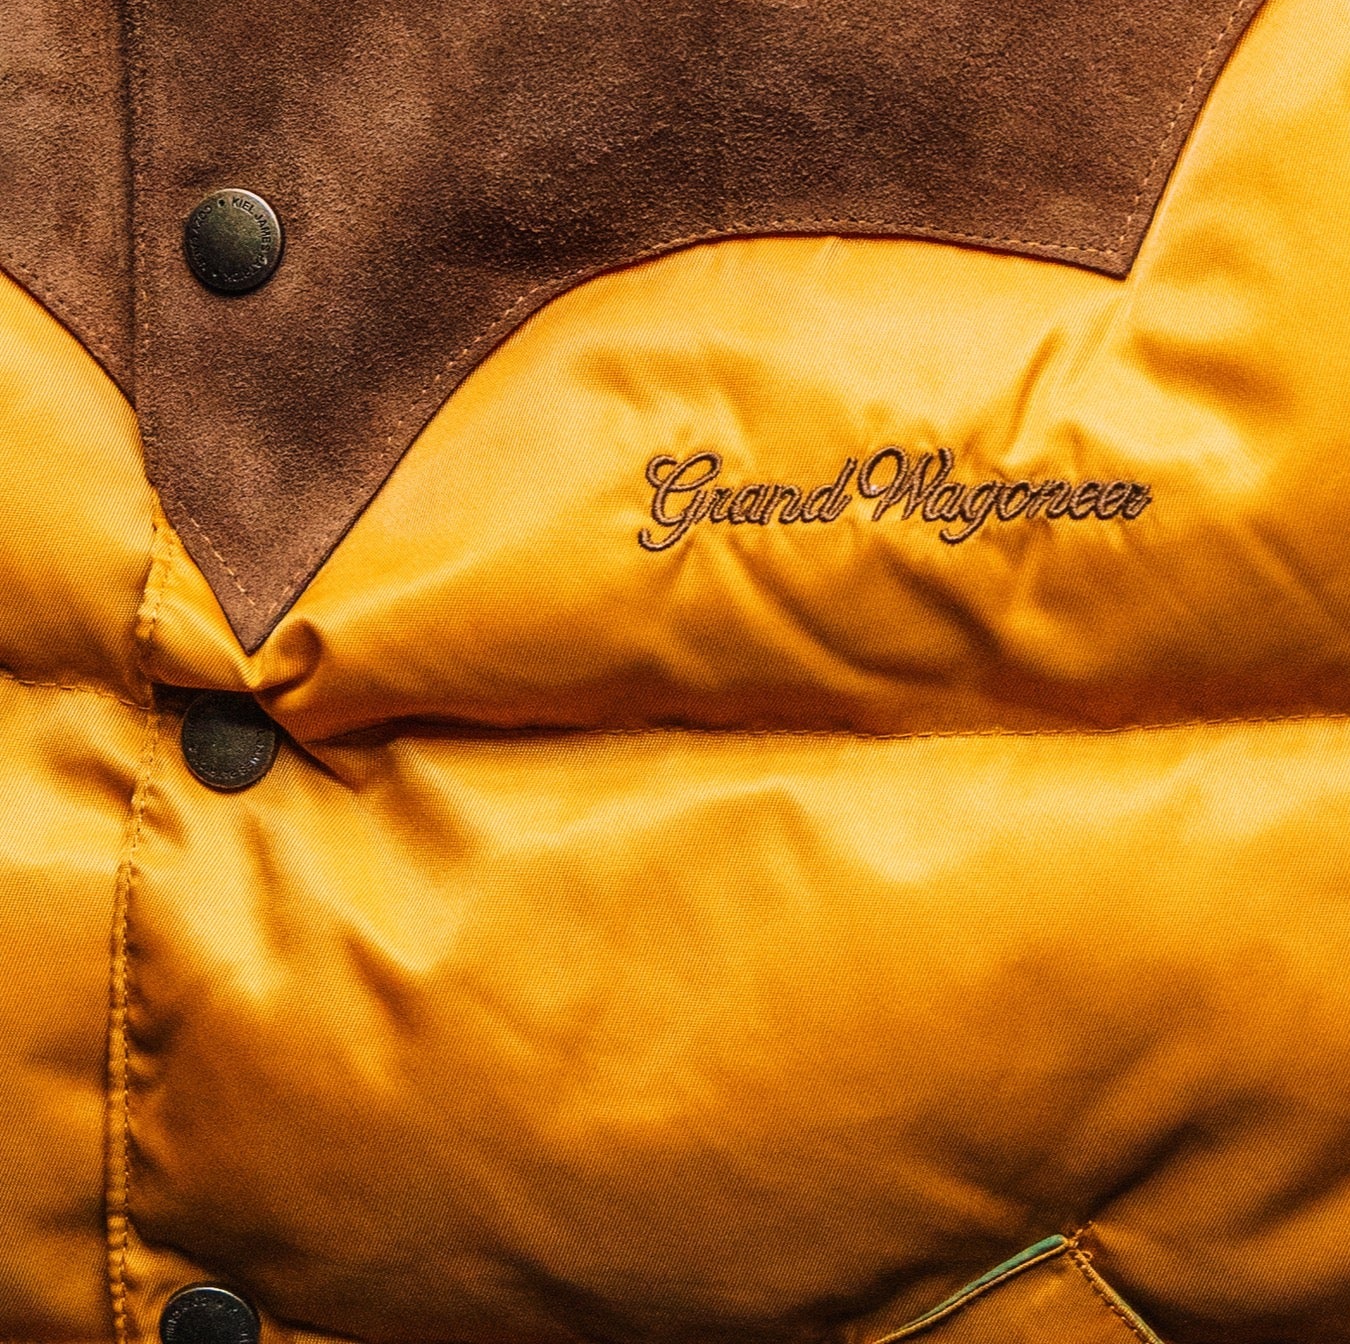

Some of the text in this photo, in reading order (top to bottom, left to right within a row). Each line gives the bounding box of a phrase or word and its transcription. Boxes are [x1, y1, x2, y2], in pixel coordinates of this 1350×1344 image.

[232, 197, 255, 215] KIEL
[254, 214, 272, 251] JAMES
[637, 444, 1153, 553] Grand Wagoneer
